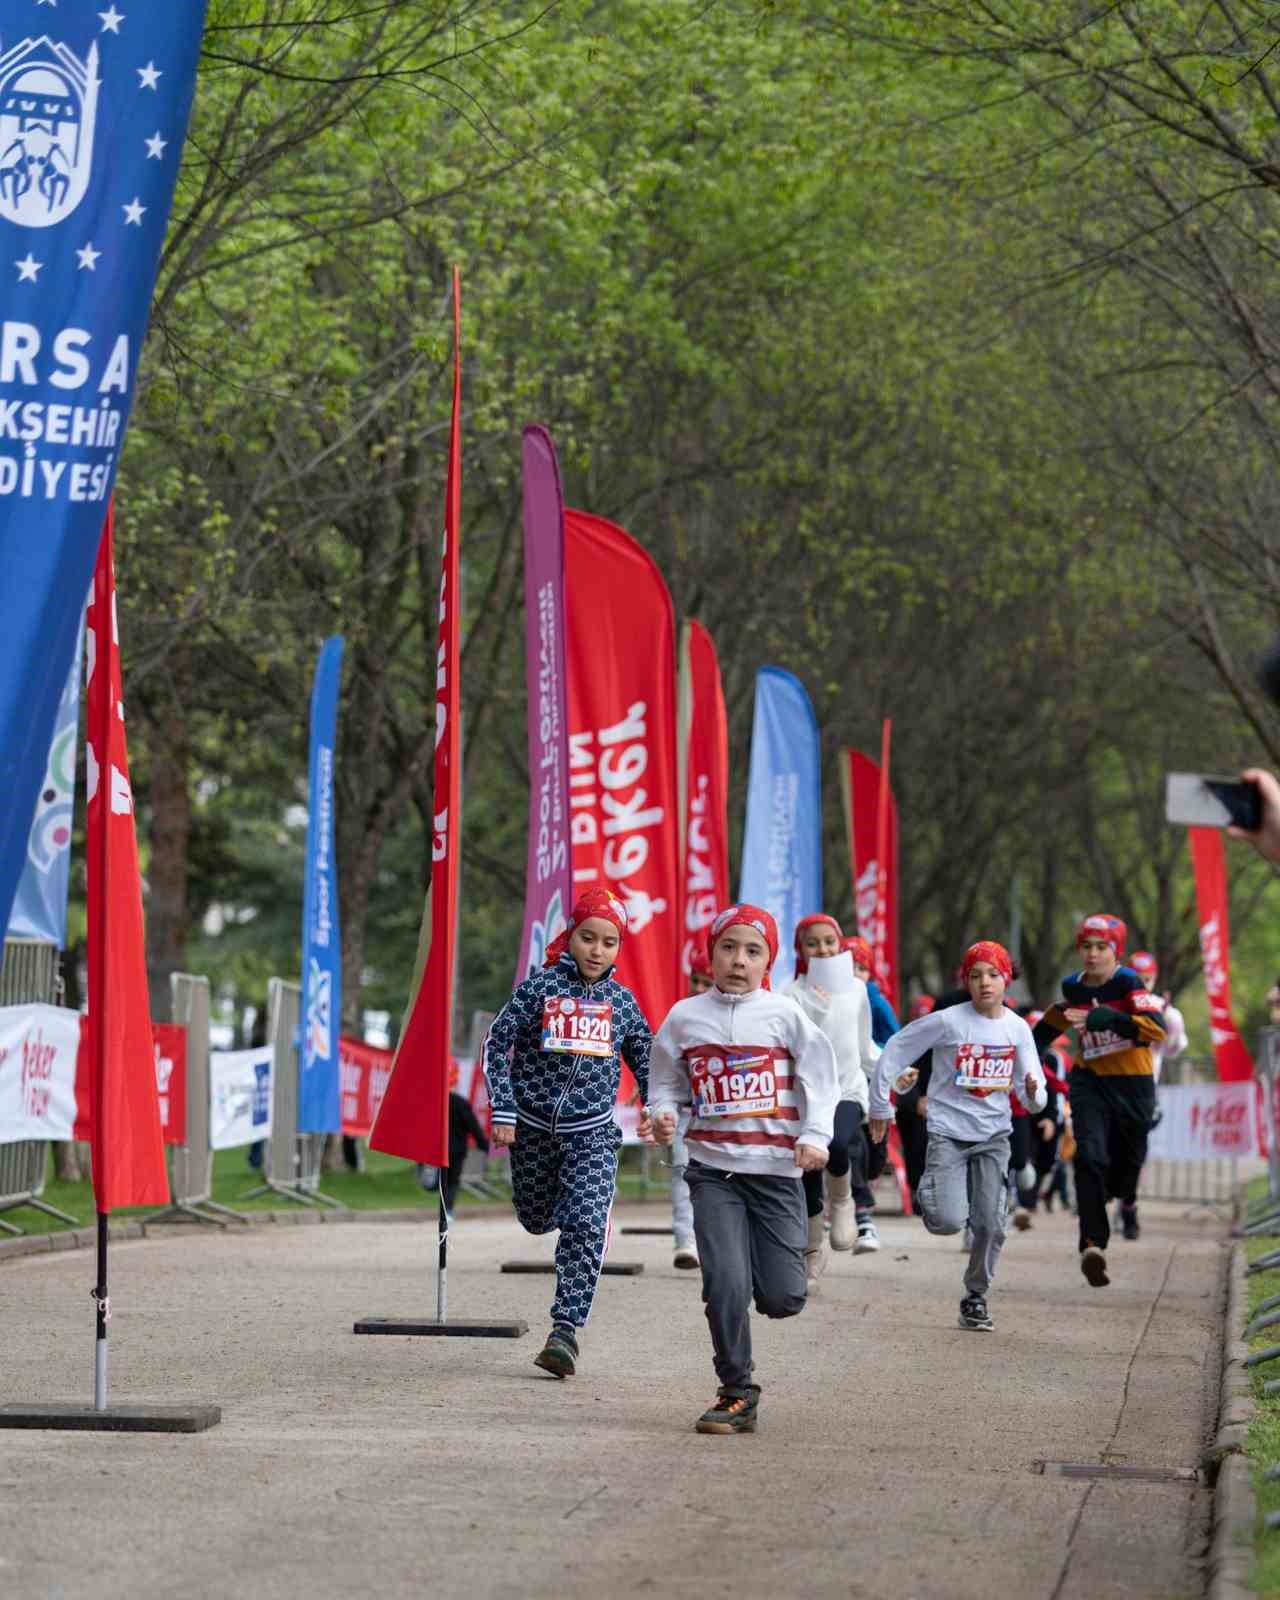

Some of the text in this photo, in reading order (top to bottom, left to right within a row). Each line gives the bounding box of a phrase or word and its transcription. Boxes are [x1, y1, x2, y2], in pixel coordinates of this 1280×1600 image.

[568, 1015, 610, 1041] 1920
[976, 1057, 1013, 1078] 1920
[718, 1070, 775, 1101] 1920
